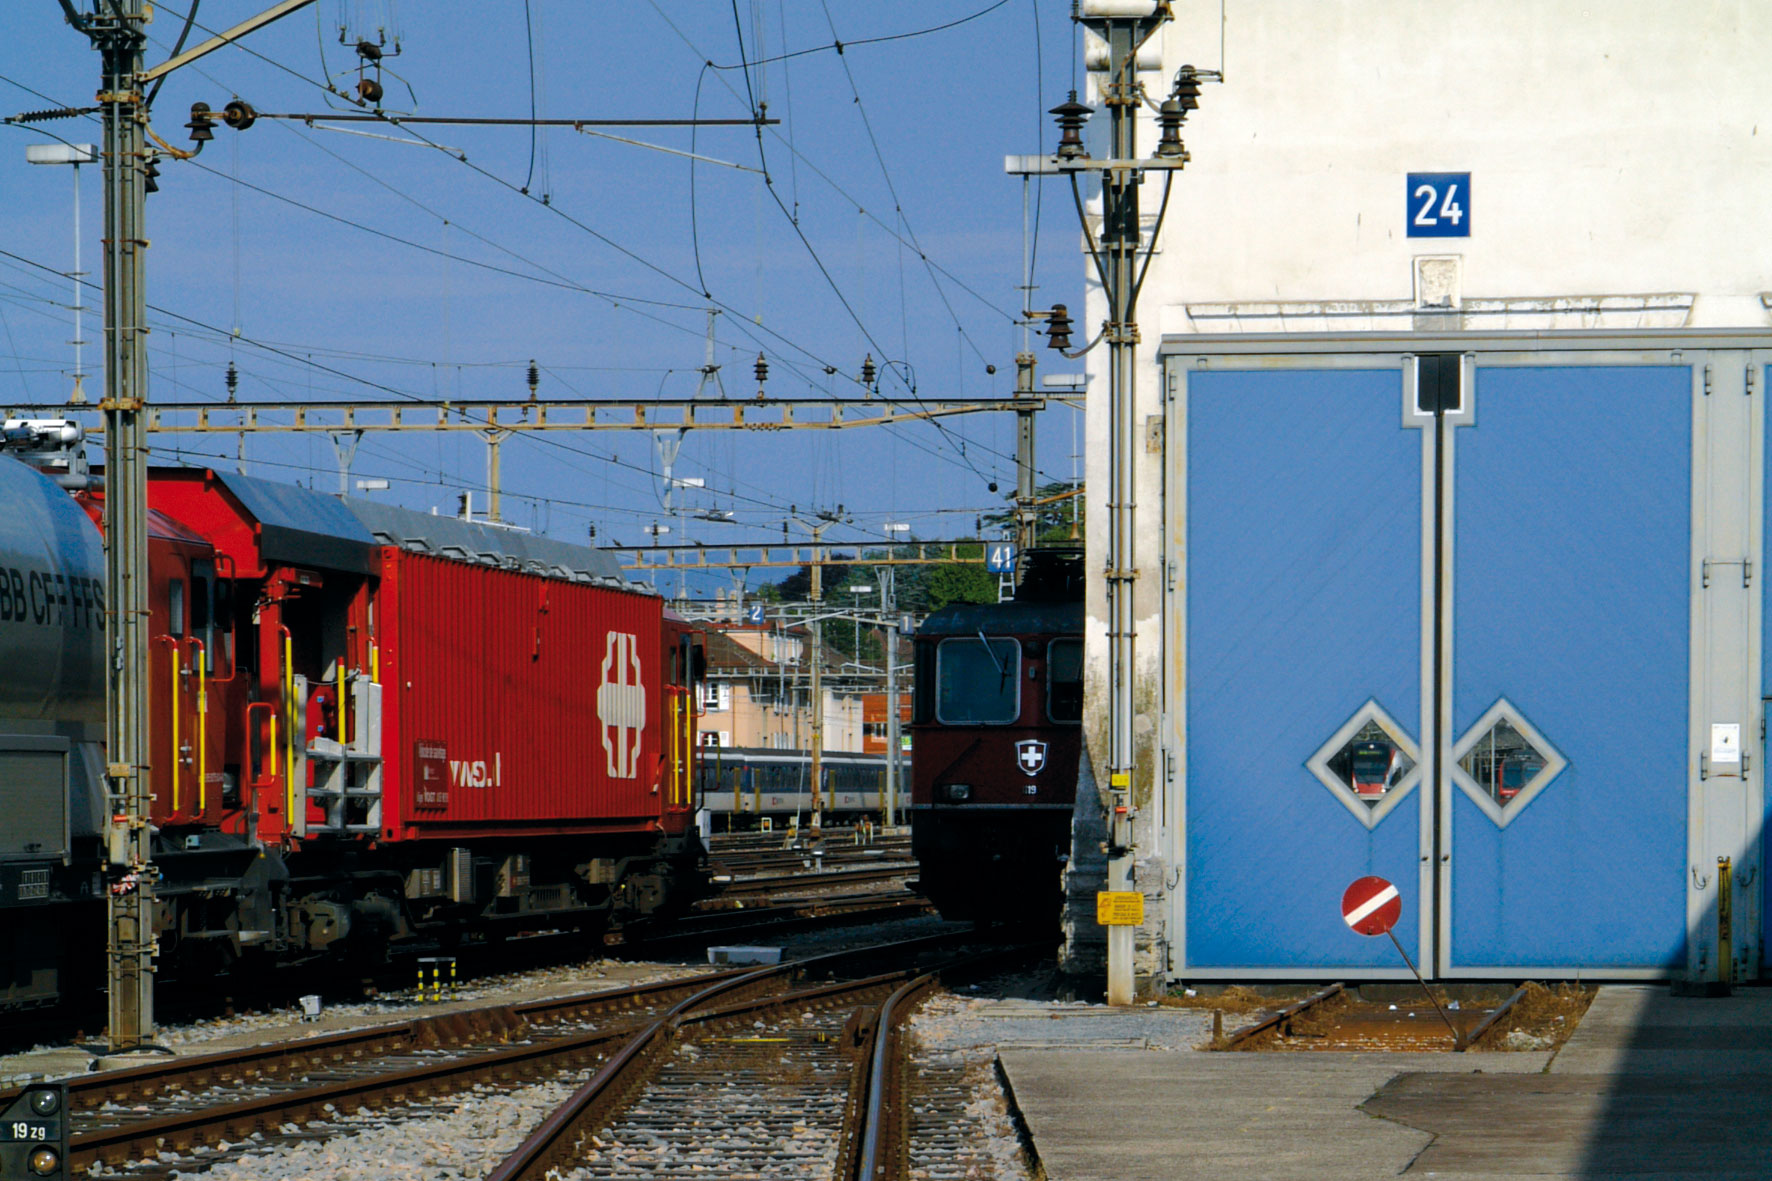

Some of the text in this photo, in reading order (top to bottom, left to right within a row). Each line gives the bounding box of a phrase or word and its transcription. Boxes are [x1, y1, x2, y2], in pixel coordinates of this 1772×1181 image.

[1414, 184, 1463, 226] 24
[991, 546, 1011, 569] 41
[29, 570, 67, 626] CFF
[69, 575, 106, 631] FFS
[751, 605, 761, 621] 2
[12, 1122, 46, 1141] 19 zg
